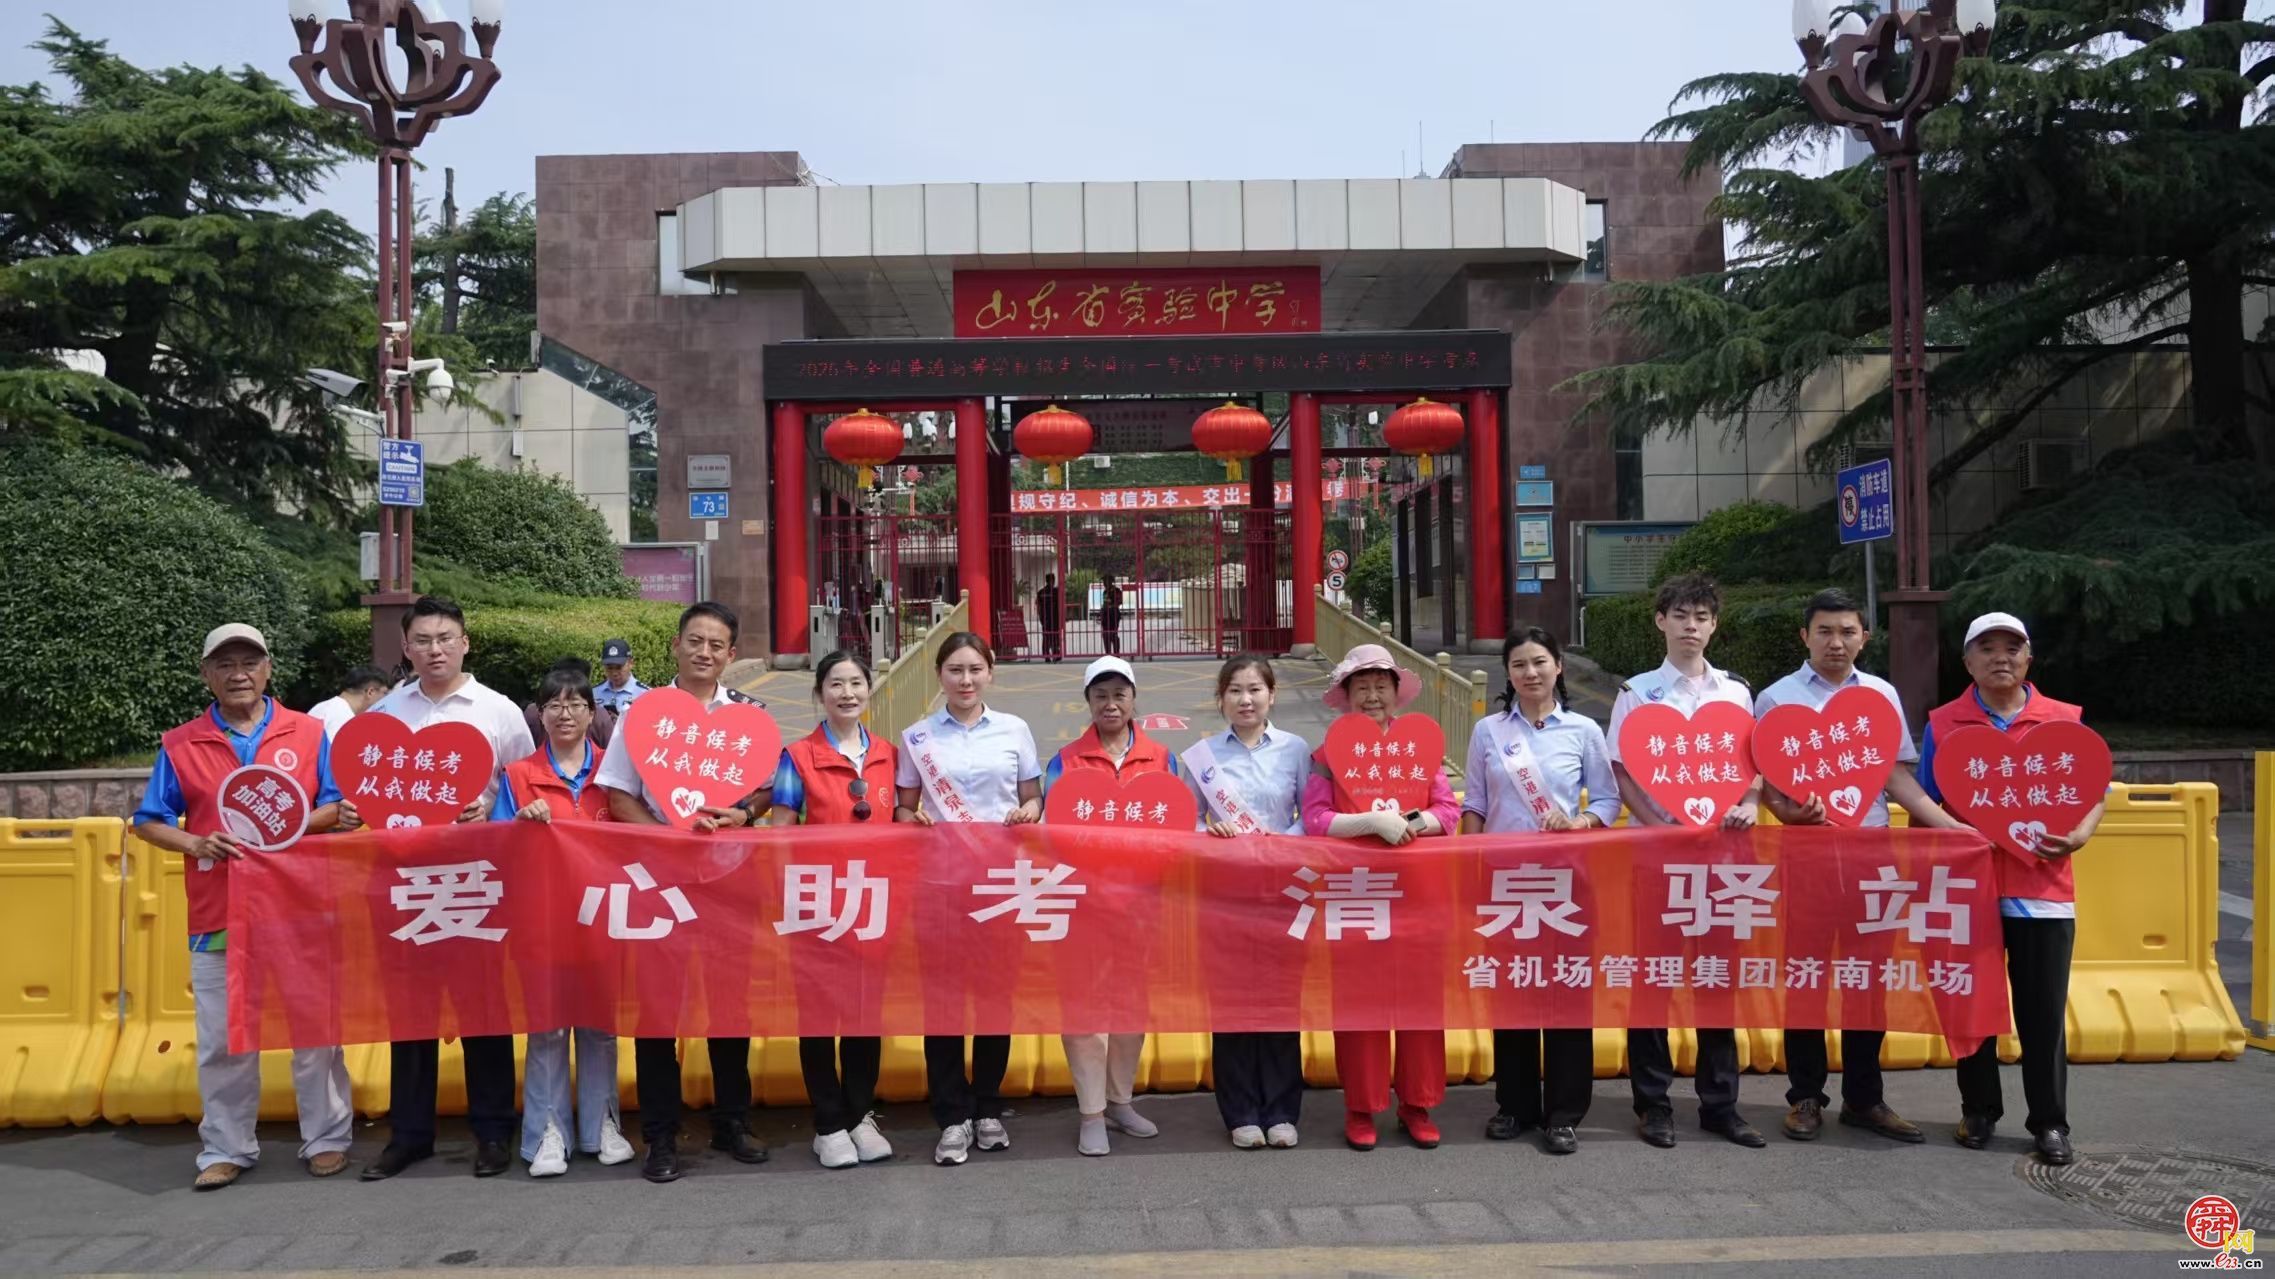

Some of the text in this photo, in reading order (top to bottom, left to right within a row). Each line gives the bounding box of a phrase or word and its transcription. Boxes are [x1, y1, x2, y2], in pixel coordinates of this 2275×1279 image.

[975, 279, 1286, 331] 山东省实验中学
[1860, 468, 1888, 497] 消防车道
[703, 501, 715, 513] 73
[1861, 504, 1889, 532] 禁止占用
[1333, 576, 1342, 587] 5
[651, 715, 752, 757] 静音候考
[1352, 741, 1416, 757] 静音候考
[1646, 731, 1735, 757] 静音候考
[1780, 715, 1873, 757] 静音候考
[358, 743, 462, 775] 静音候考
[645, 748, 745, 787] 从我做起
[1344, 764, 1428, 781] 从我做起
[1651, 761, 1743, 785] 从我做起
[1791, 746, 1886, 786] 从我做起
[1964, 752, 2075, 780] 静音候考
[256, 776, 295, 812] 高考
[356, 776, 460, 805] 从我做起
[1969, 783, 2083, 808] 从我做起
[232, 784, 287, 837] 加油站
[1072, 798, 1168, 824] 静音候考
[390, 859, 1976, 945] 爱心助考 清泉驿站
[1462, 955, 1973, 996] 省机场管理集团济南机场
